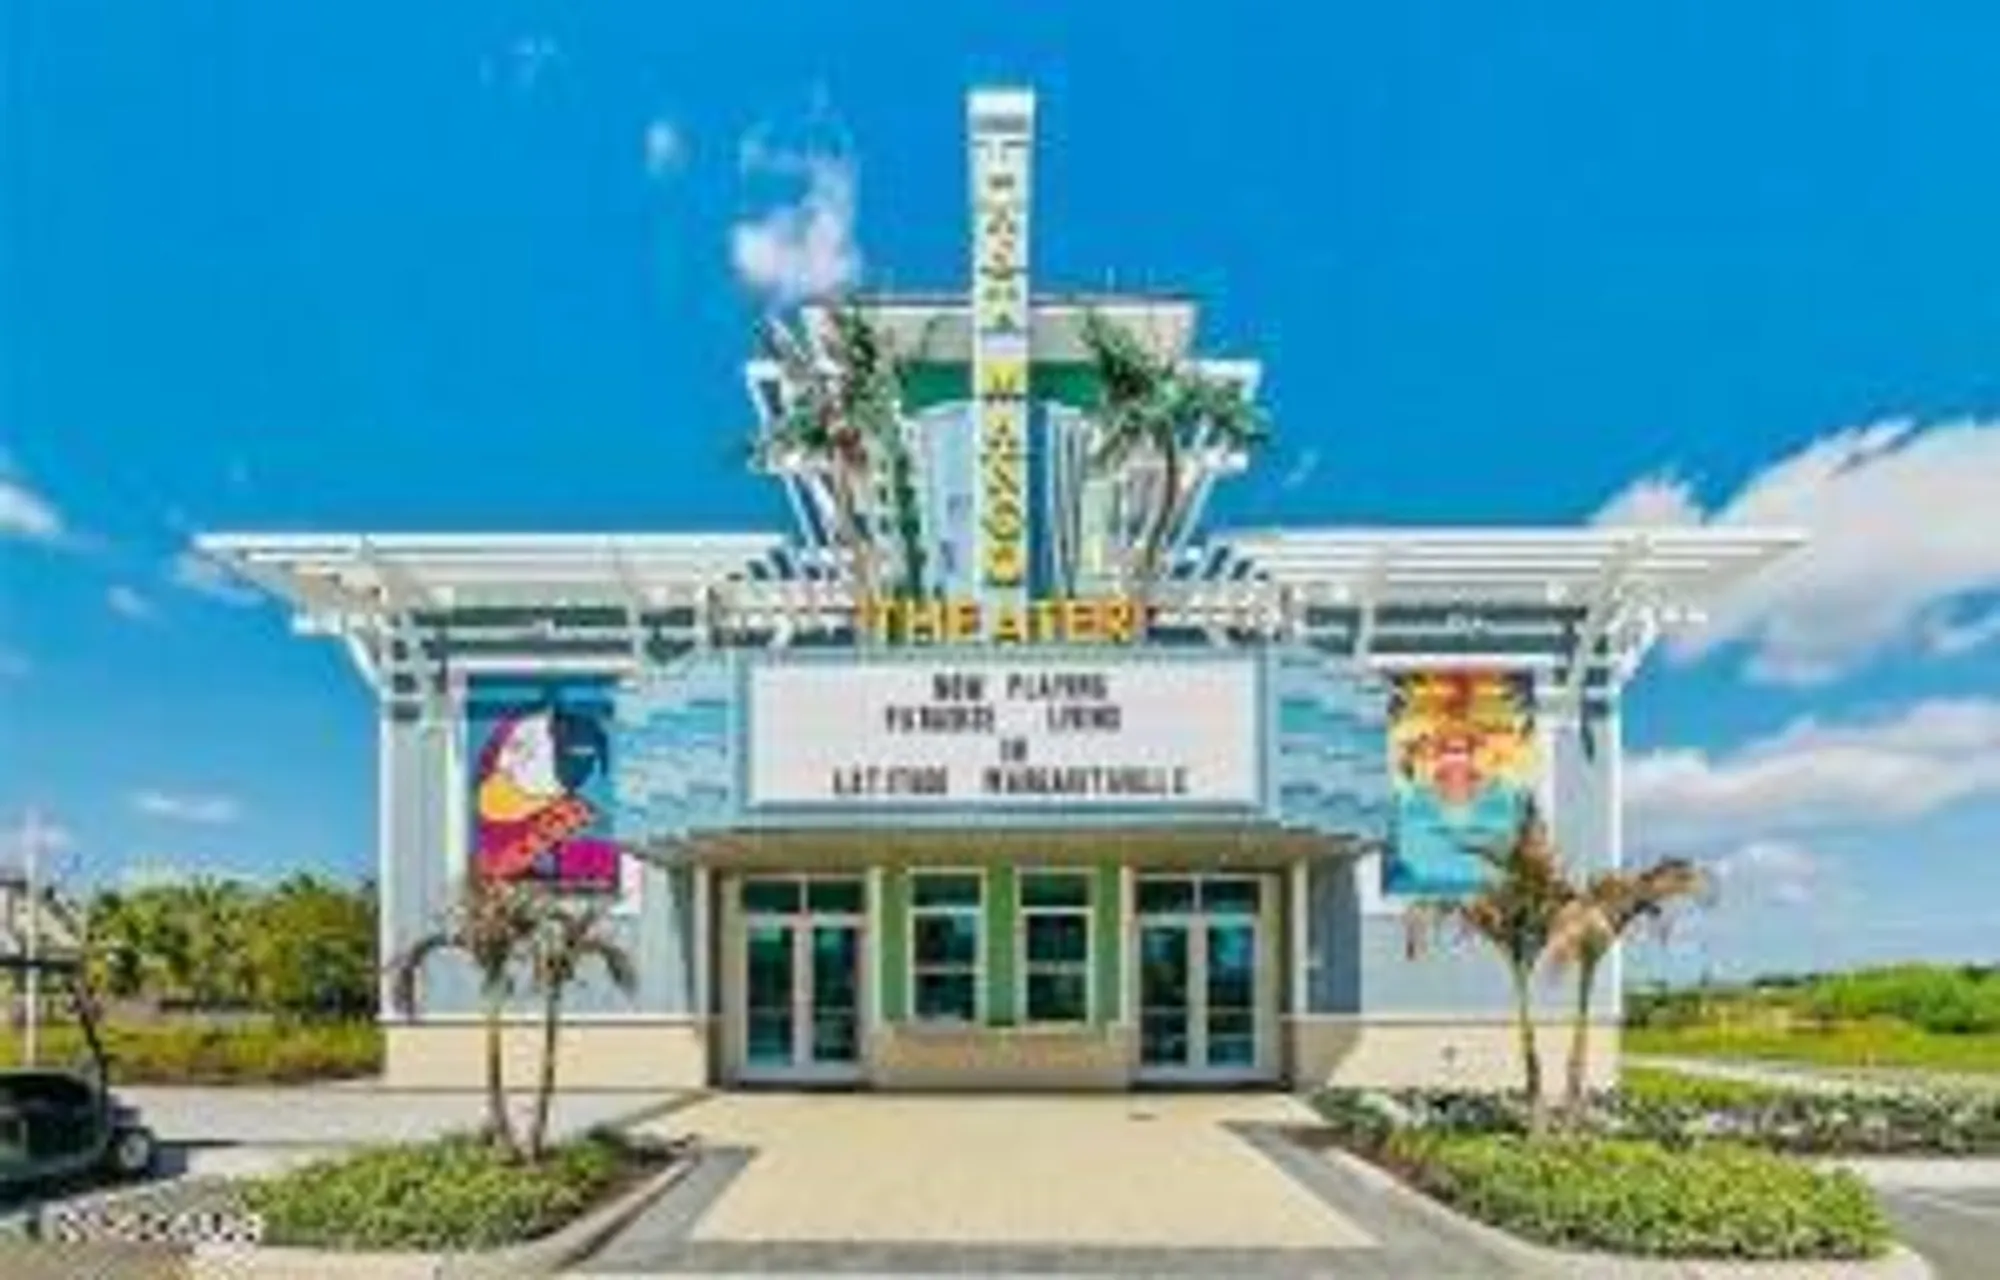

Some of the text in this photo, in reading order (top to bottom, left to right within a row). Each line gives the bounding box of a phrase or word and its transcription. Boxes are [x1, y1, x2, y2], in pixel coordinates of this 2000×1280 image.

[866, 597, 1142, 643] THEATER
[933, 673, 1108, 702] NOW PLAYING
[1047, 704, 1121, 731] LIVING
[1000, 738, 1028, 762] IN
[833, 766, 1189, 794] LATITUDE MARGARITAVILLE
